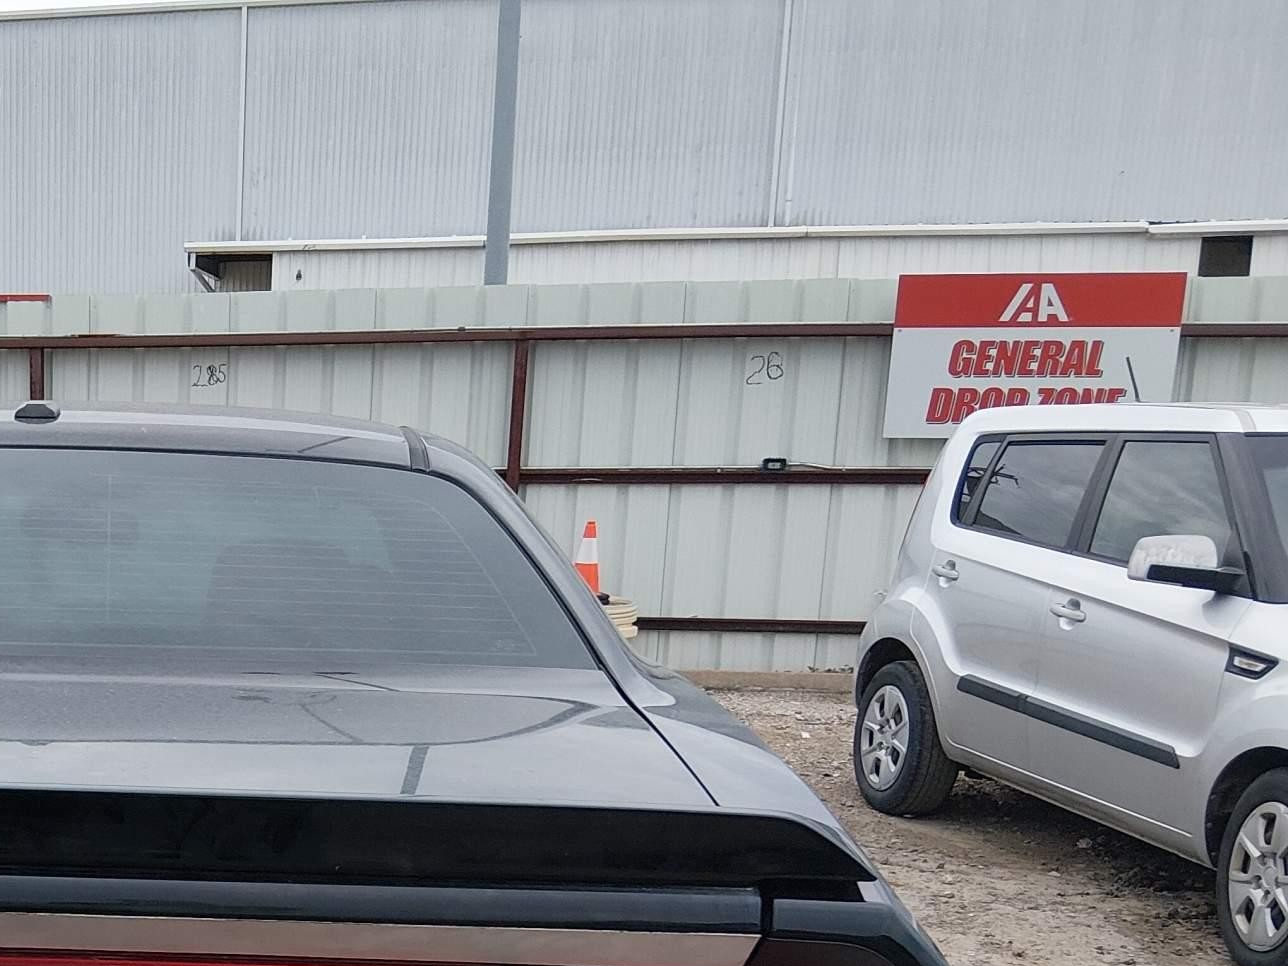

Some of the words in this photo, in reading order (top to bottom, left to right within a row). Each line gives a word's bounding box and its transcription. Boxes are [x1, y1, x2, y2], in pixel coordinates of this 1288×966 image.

[998, 282, 1070, 322] IAA
[745, 351, 784, 385] 26
[947, 339, 1105, 378] GENERAL
